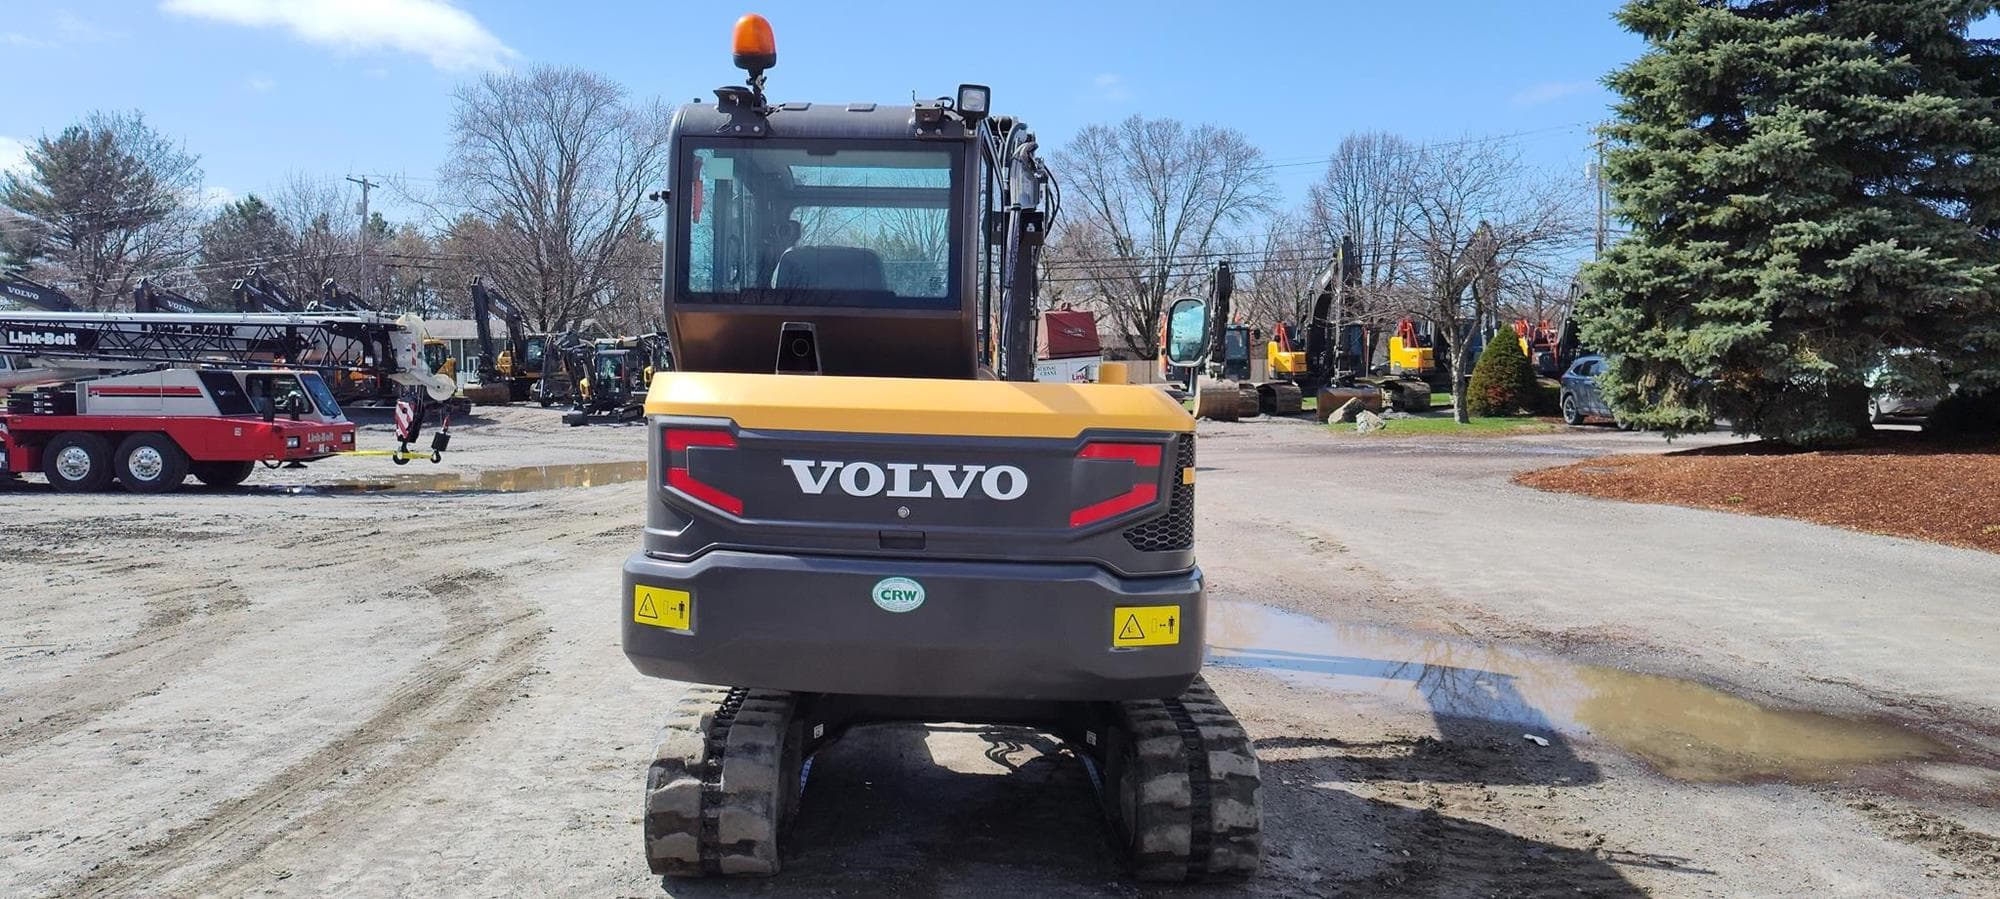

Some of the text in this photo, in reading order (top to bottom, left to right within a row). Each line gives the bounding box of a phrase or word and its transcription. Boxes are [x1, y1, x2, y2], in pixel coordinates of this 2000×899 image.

[7, 286, 39, 300] VOLVO
[167, 300, 194, 313] VOLVO
[9, 331, 76, 345] Link-Belt
[783, 459, 1028, 500] VOLVO
[881, 590, 917, 601] CRW
